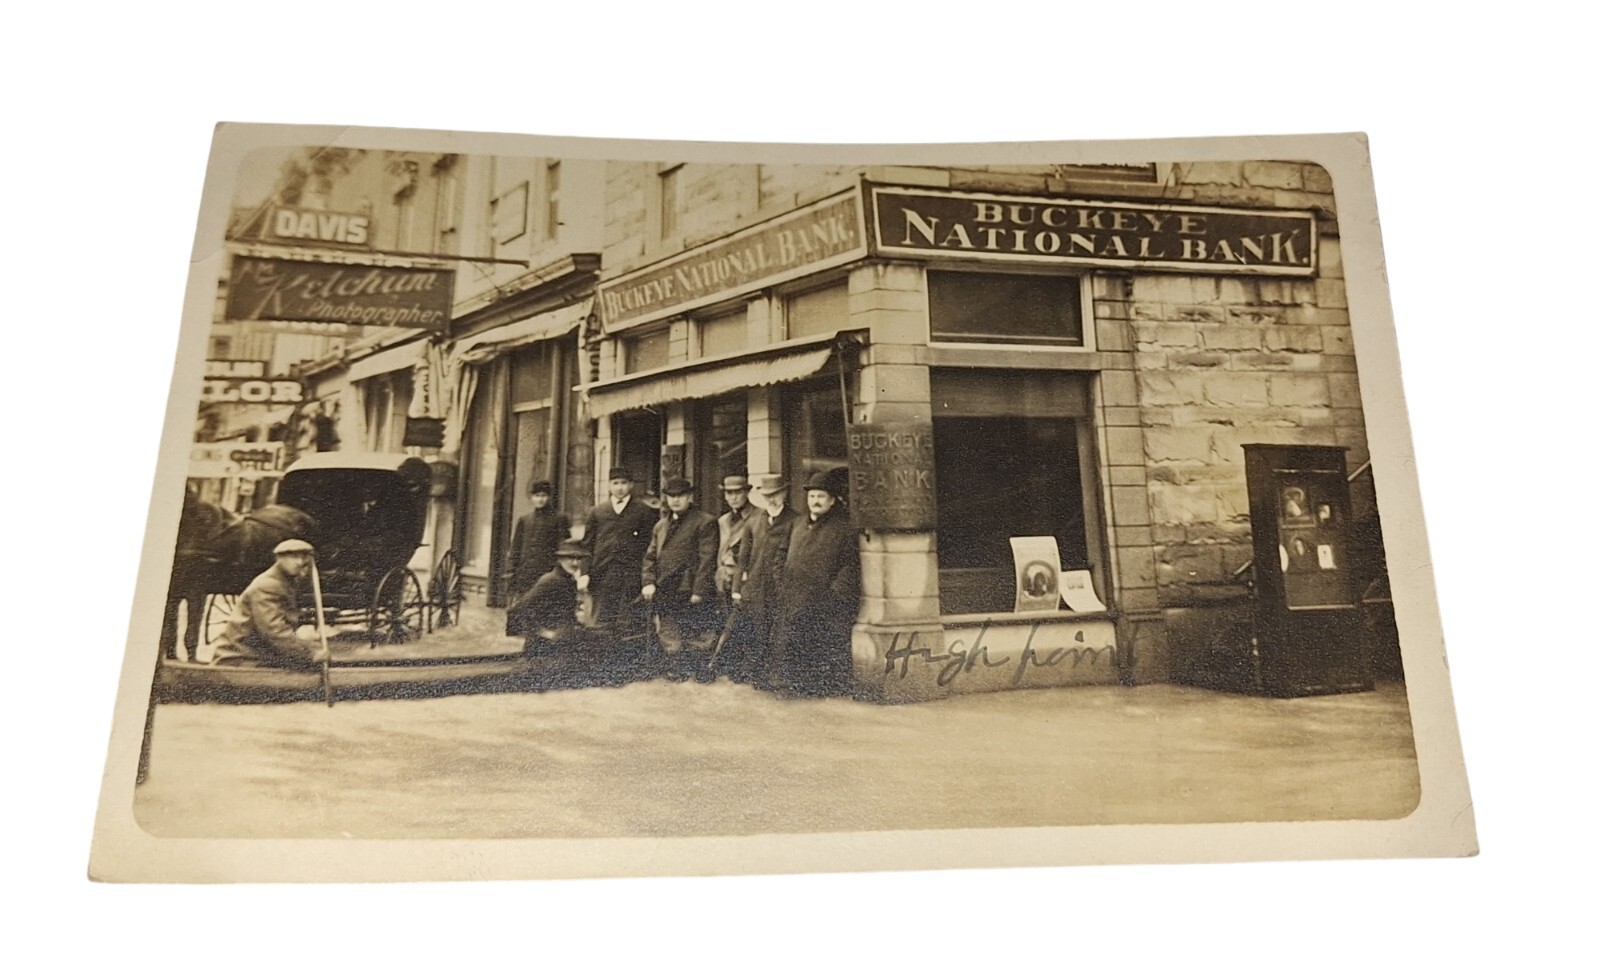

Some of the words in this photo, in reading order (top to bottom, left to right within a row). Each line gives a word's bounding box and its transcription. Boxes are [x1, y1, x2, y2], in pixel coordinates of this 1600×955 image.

[276, 210, 369, 244] DAVIS
[972, 202, 1208, 235] BUCKEYE
[901, 207, 1165, 259] NATIONAL
[1179, 229, 1309, 265] BANK.
[605, 274, 674, 322] BUCKEYE
[676, 243, 772, 292] NATIONAL
[850, 432, 933, 450] BUCKEYE
[854, 469, 930, 491] BANK
[884, 617, 1011, 687] High
